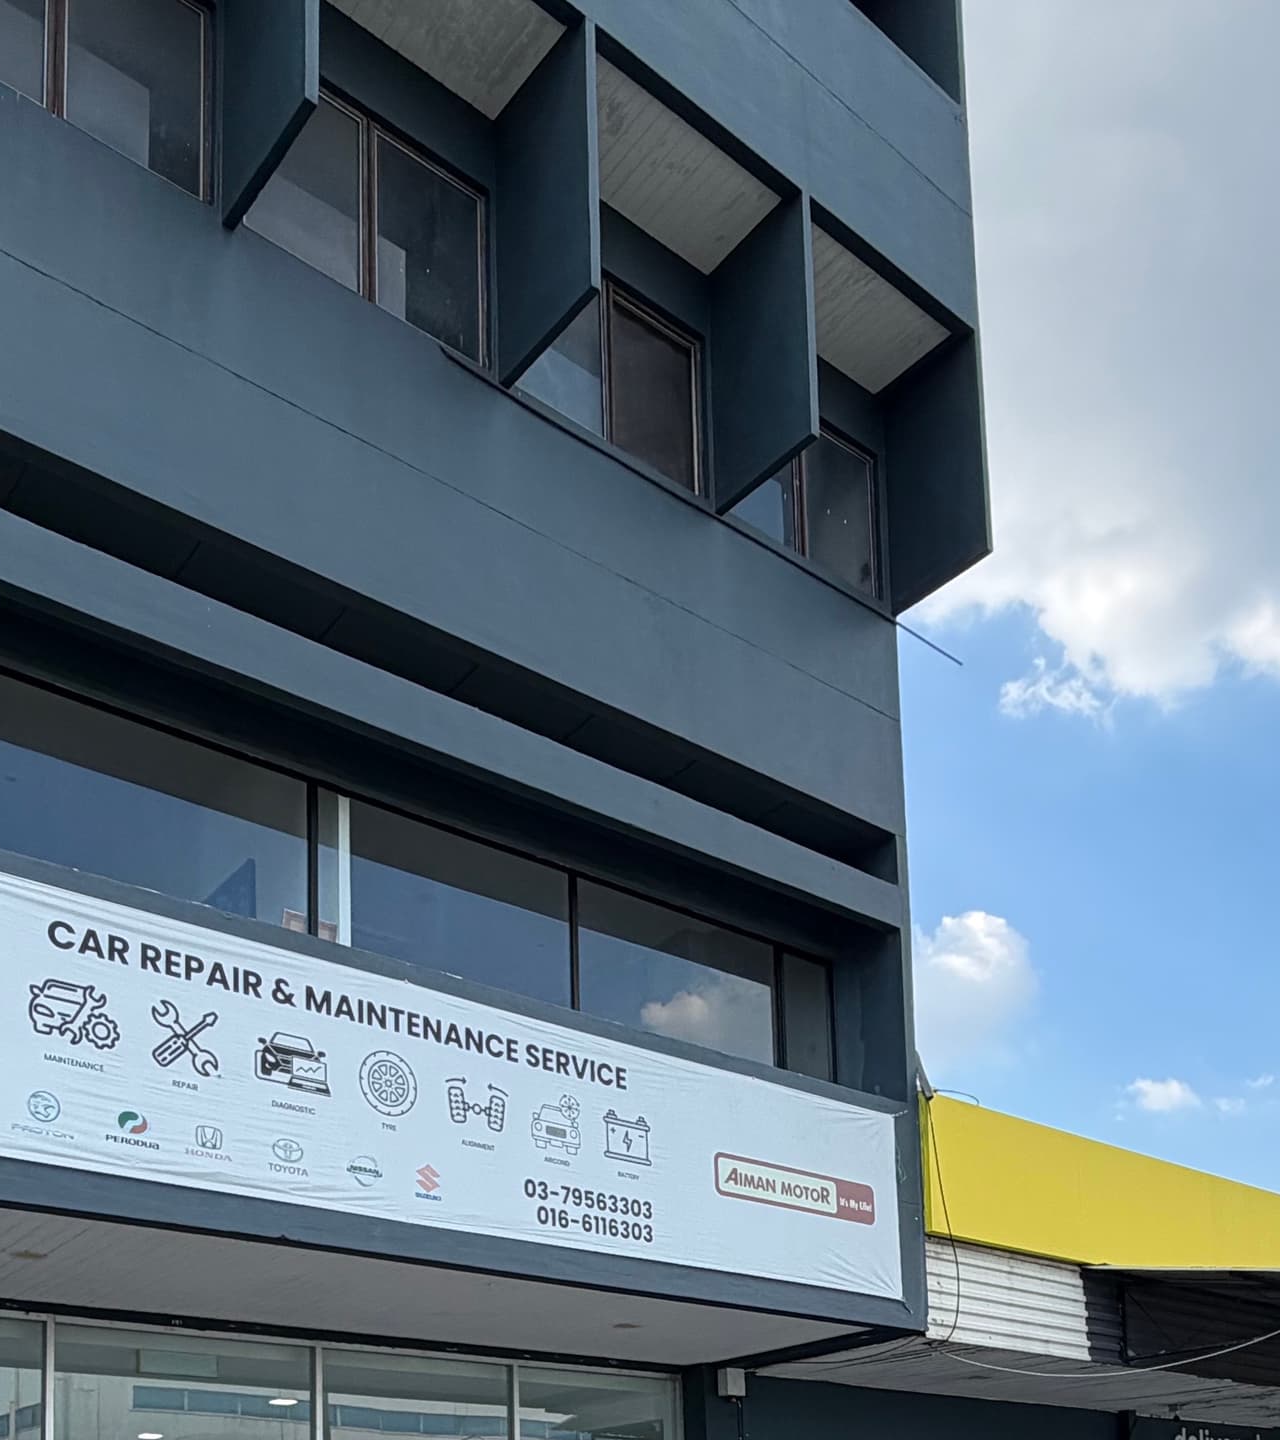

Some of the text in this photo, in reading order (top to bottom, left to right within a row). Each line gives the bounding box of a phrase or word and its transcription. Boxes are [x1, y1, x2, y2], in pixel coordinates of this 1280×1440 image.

[47, 920, 628, 1091] CAR REPAIR & MAINTENANCE SERVICE
[43, 1052, 105, 1073] MAINTENANCE
[172, 1079, 199, 1092] REPAIR
[271, 1099, 316, 1116] DIAGNOSTIC
[381, 1122, 397, 1132] TYRE
[184, 1147, 233, 1163] HONDA
[268, 1162, 310, 1178] TOYOTA
[724, 1167, 831, 1205] AIMAN MOTOR
[524, 1179, 653, 1220] 03-79563303
[537, 1206, 654, 1243] 016-6116303
